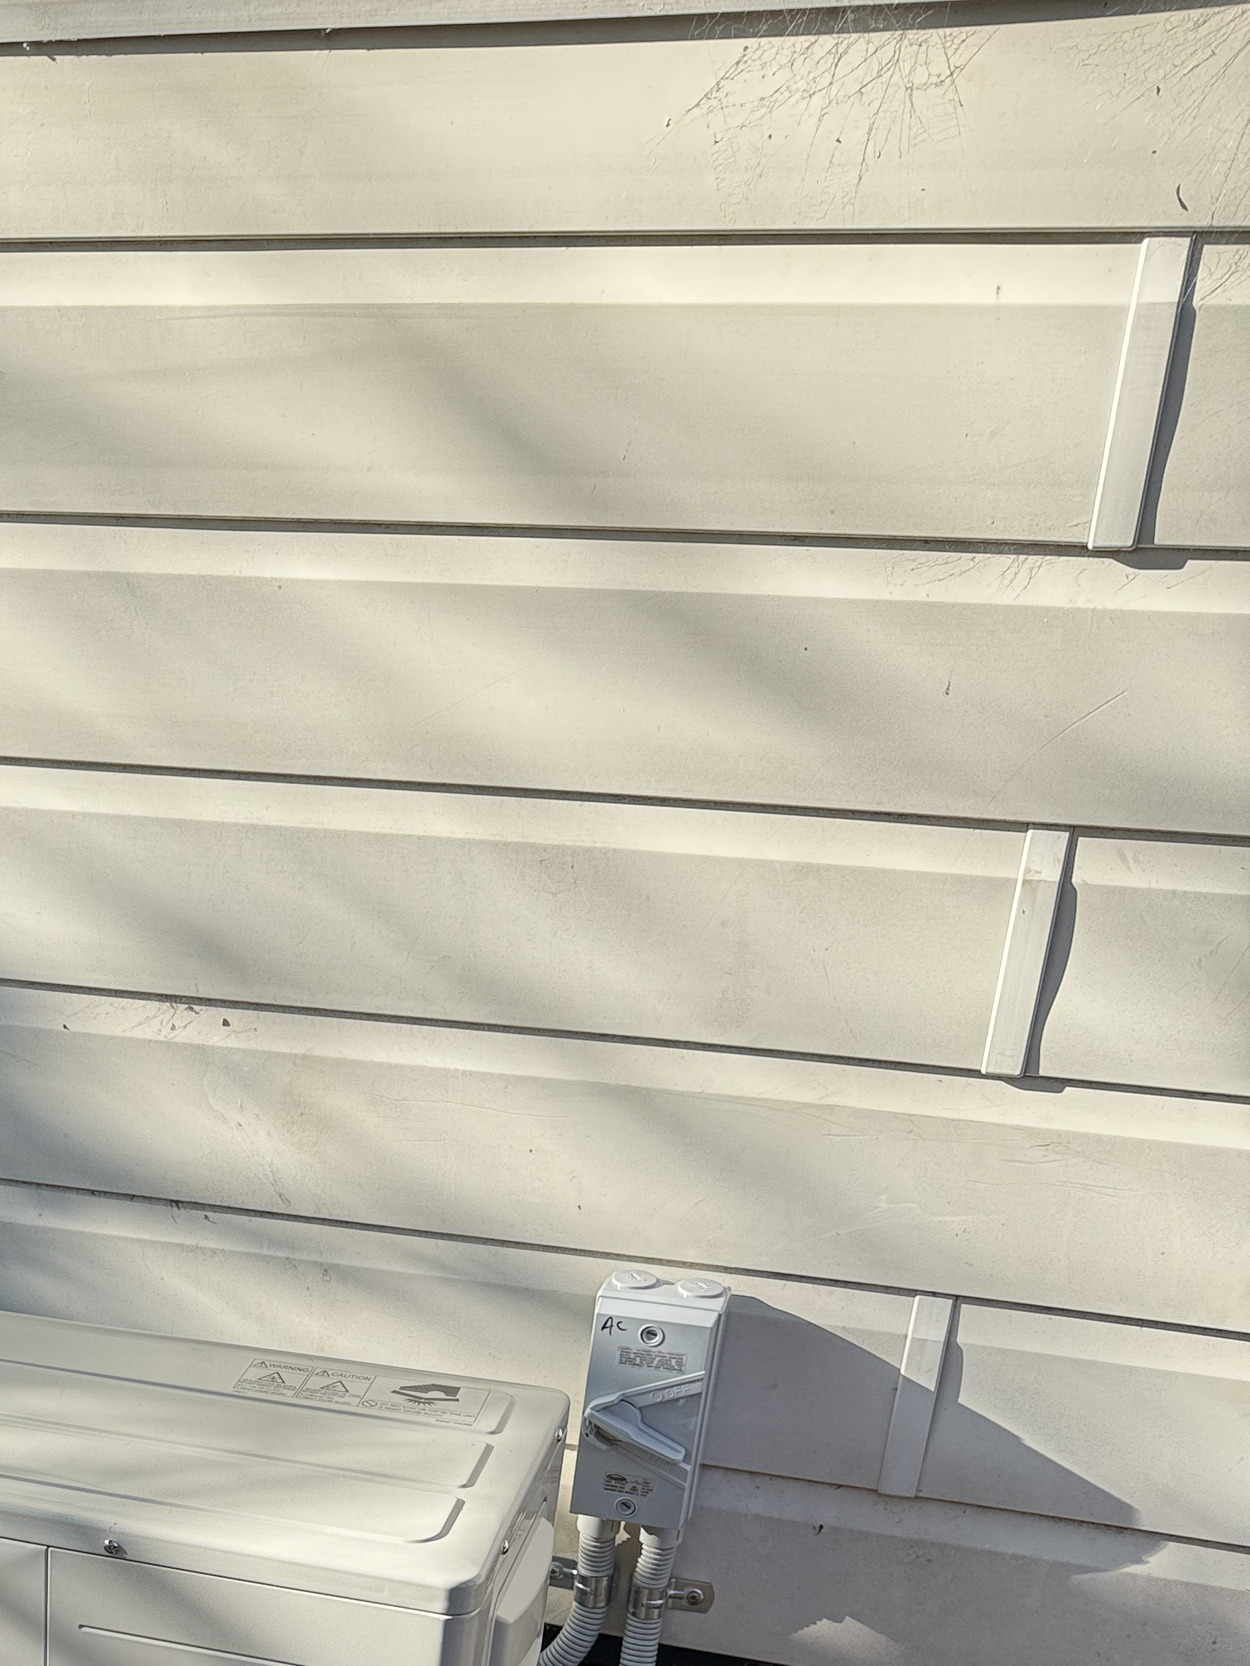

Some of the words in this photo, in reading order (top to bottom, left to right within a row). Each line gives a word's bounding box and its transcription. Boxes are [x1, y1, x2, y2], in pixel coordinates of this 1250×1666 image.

[268, 1362, 310, 1373] WARNING
[331, 1371, 372, 1382] CAUTION
[664, 1384, 690, 1398] OFF
